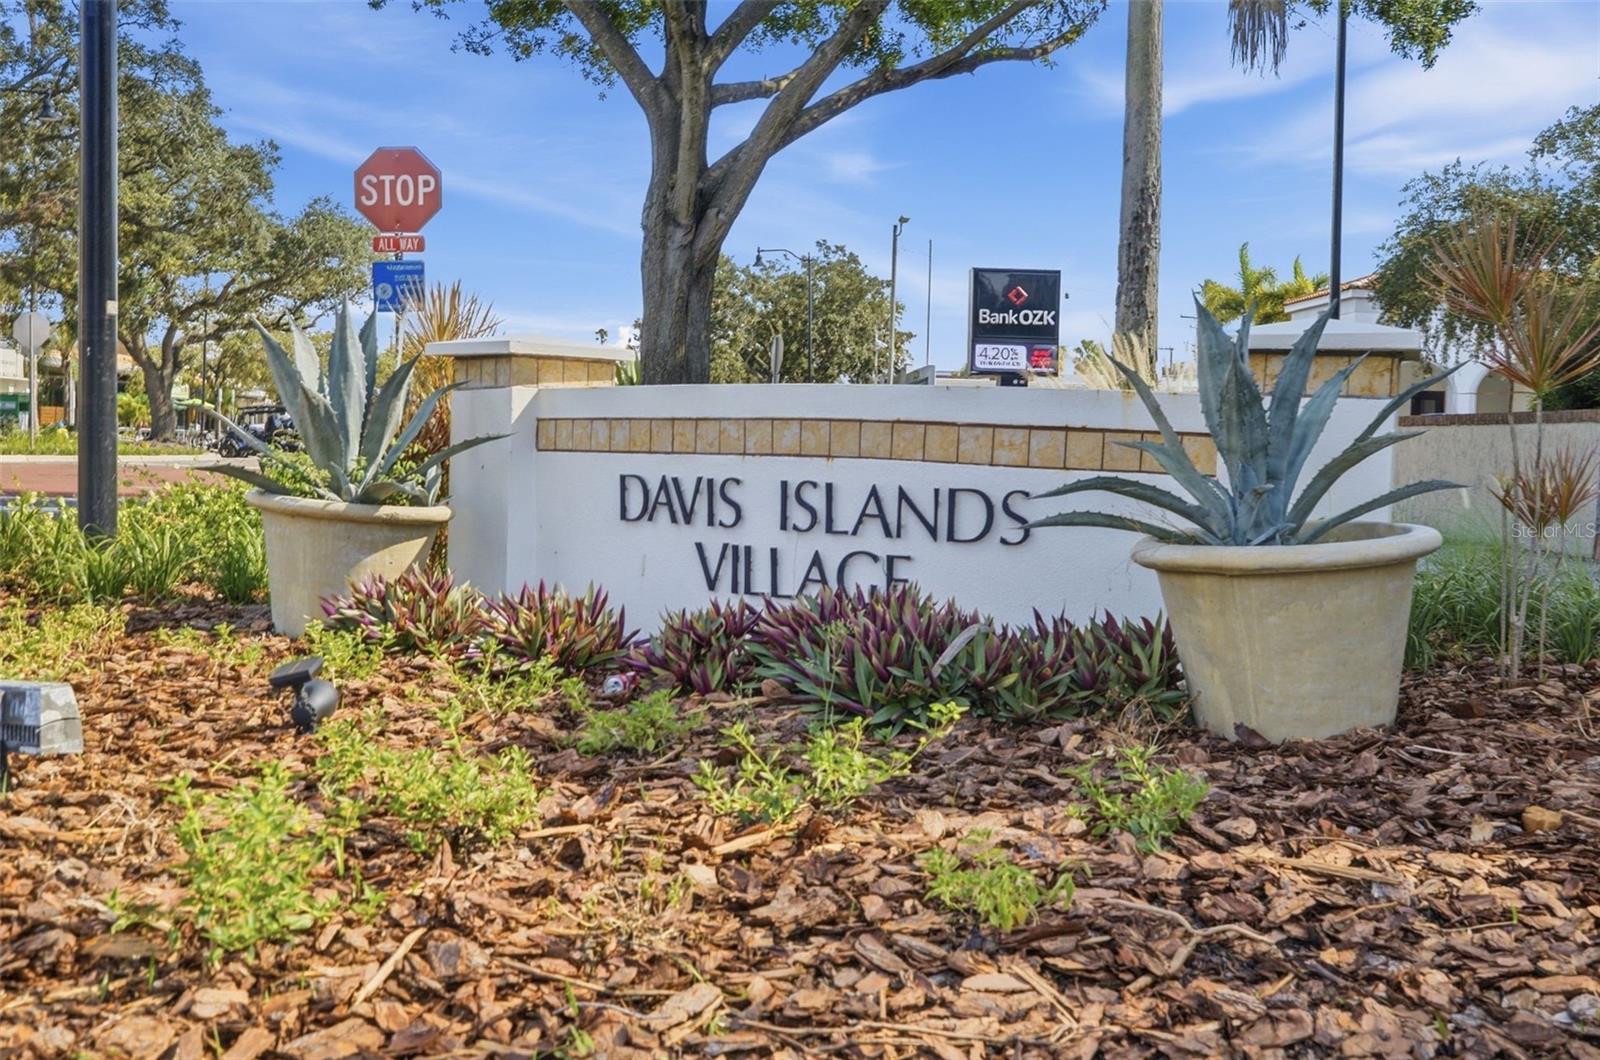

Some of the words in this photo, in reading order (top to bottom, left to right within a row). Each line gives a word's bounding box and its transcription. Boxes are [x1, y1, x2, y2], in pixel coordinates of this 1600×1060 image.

[360, 174, 436, 207] STOP
[378, 238, 396, 251] ALL
[400, 238, 420, 251] WAY
[619, 474, 743, 529] DAVIS
[779, 480, 1032, 547] ISLANDS
[694, 541, 913, 602] VILLAGE
